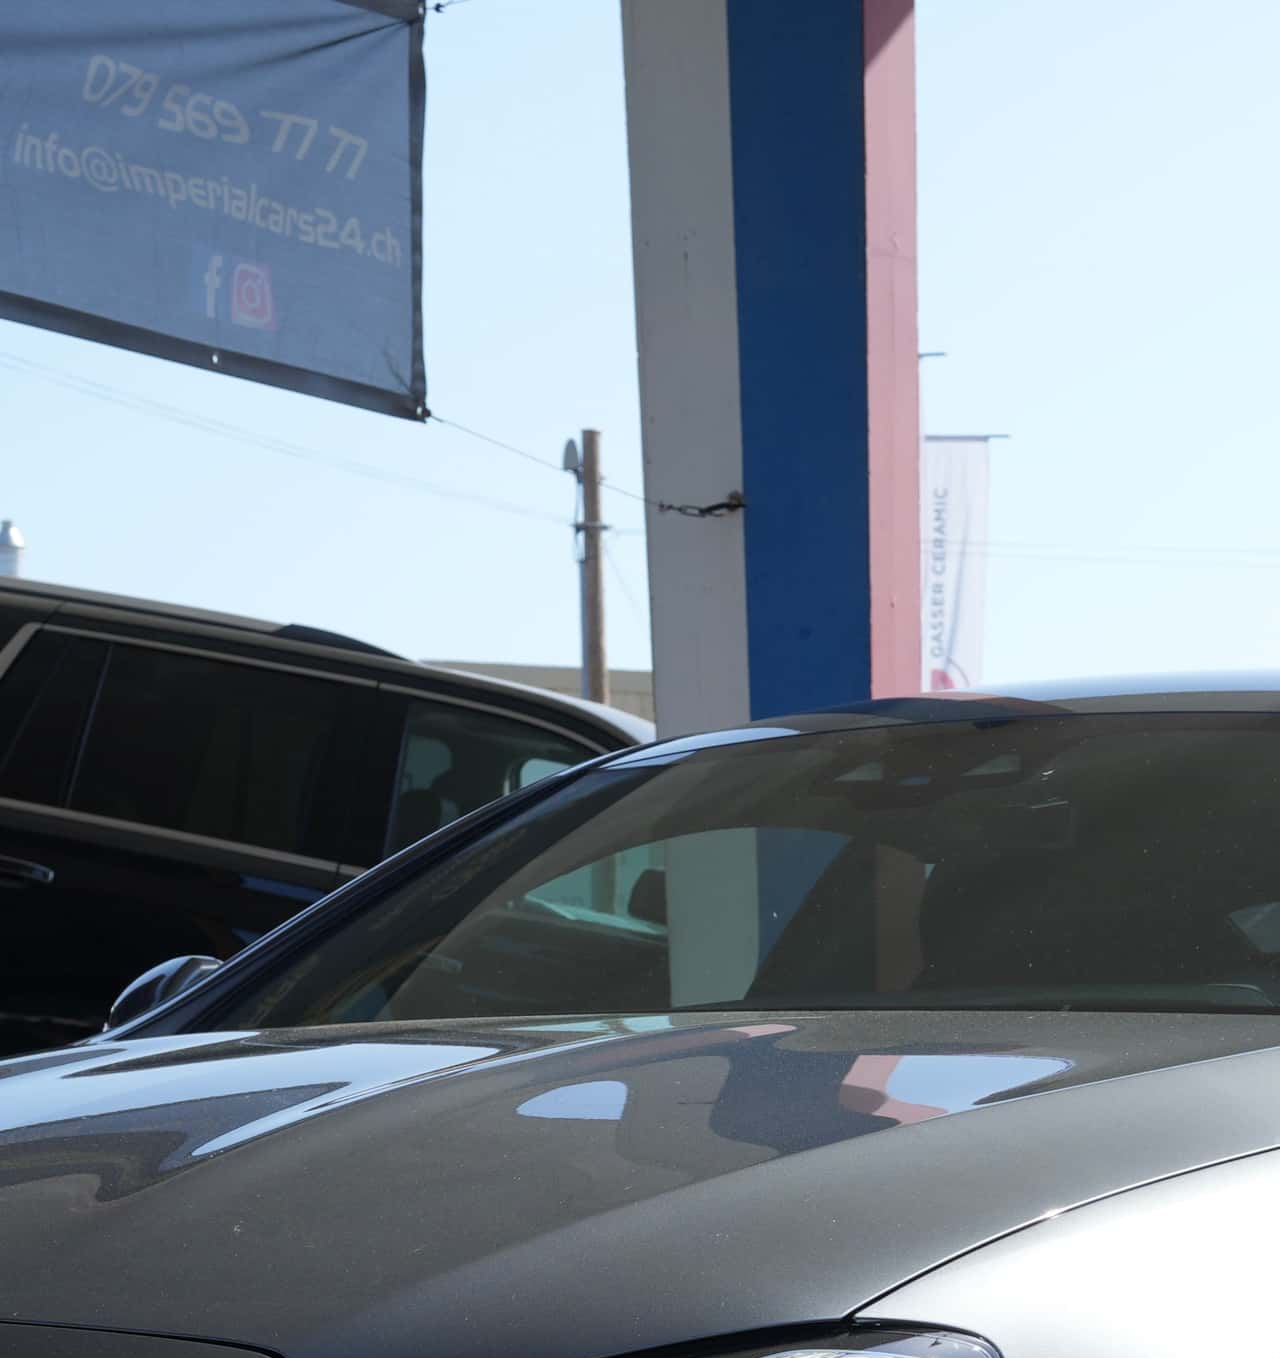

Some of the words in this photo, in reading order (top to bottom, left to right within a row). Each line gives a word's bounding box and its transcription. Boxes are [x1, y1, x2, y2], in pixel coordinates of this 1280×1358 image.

[81, 54, 160, 118] 079
[158, 85, 251, 145] 569
[260, 110, 319, 160] 77
[326, 126, 369, 180] 77
[14, 123, 403, 268] info@imperialcars24.ch
[931, 487, 949, 576] CERAMIC
